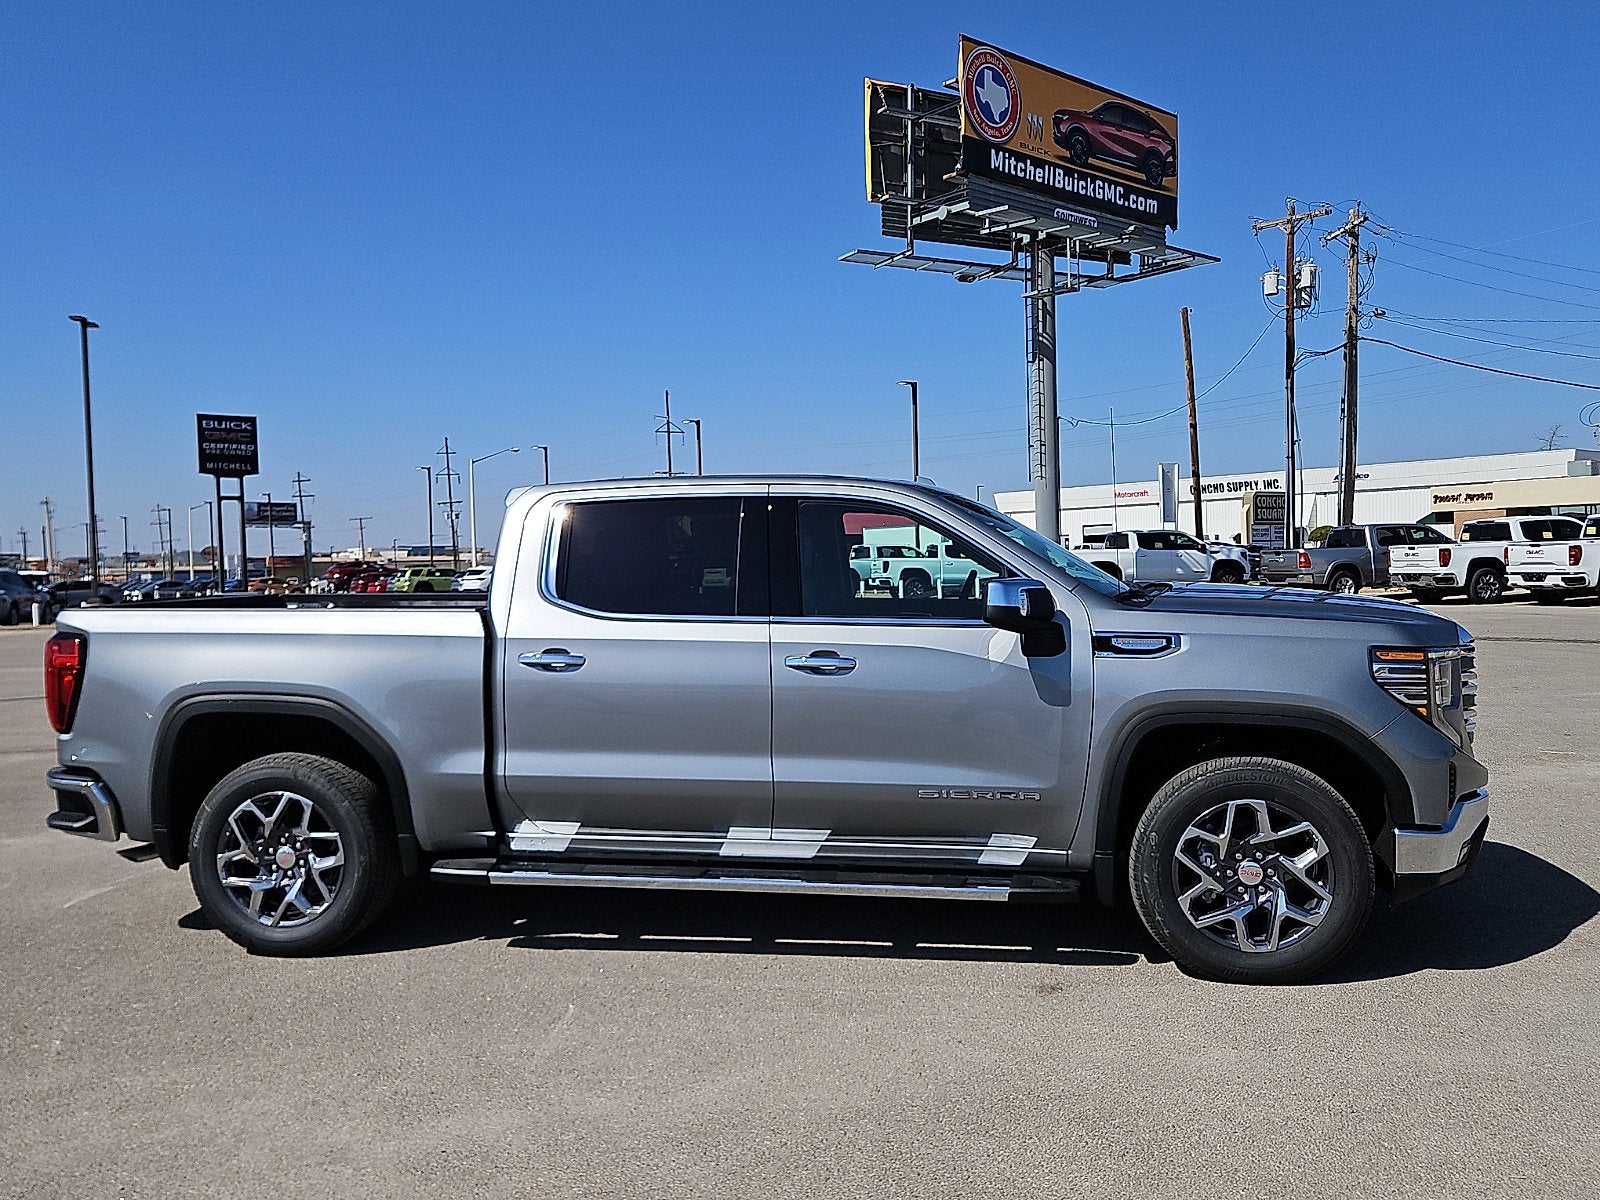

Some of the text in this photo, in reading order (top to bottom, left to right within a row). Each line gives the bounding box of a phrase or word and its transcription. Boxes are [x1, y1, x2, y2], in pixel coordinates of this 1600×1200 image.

[968, 54, 1017, 95] Mitchell Buick GMC
[973, 108, 981, 124] San
[1000, 122, 1014, 135] Texas
[1019, 141, 1051, 156] BUICK
[991, 148, 1158, 214] MitchellBuickGMC.com
[1055, 210, 1097, 227] SOUTHWEST
[202, 420, 253, 430] BUICK
[204, 431, 251, 441] GMC
[202, 442, 255, 451] CERTIFIED
[206, 462, 252, 470] MITCHELL
[1189, 483, 1225, 495] CNCHO
[1263, 478, 1282, 490] INC.
[1114, 490, 1149, 498] Motorcraft
[918, 789, 1041, 801] SIERRA
[1240, 869, 1261, 878] GMC
